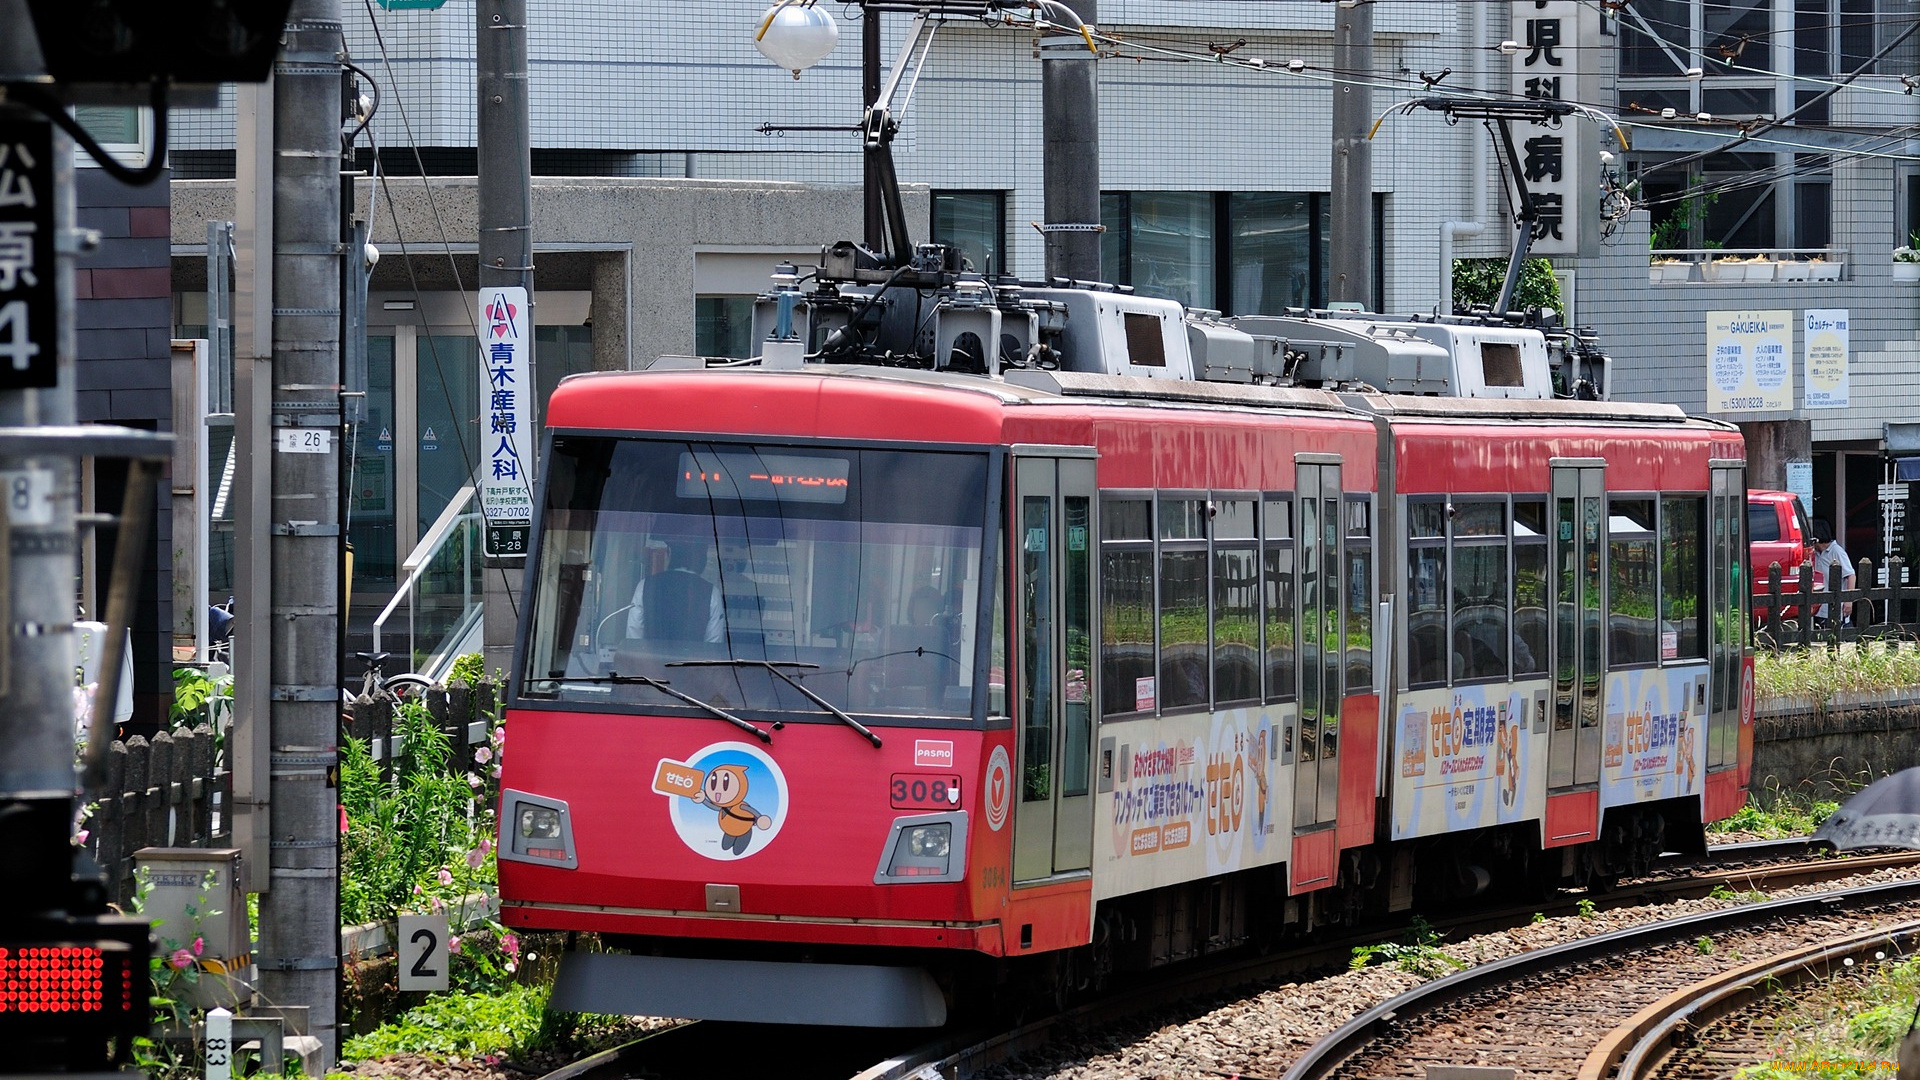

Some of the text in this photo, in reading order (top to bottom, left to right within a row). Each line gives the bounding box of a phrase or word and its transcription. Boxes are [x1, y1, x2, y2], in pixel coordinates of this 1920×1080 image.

[1524, 0, 1563, 241] 児科病院
[1731, 321, 1768, 333] GAKUEIKAI
[489, 342, 518, 481] 青木産婦人科
[304, 431, 321, 447] 26
[486, 507, 530, 517] 3327-0702
[493, 541, 522, 551] 3-28
[917, 748, 951, 758] PASMO
[892, 779, 948, 802] 308
[410, 928, 438, 977] 2
